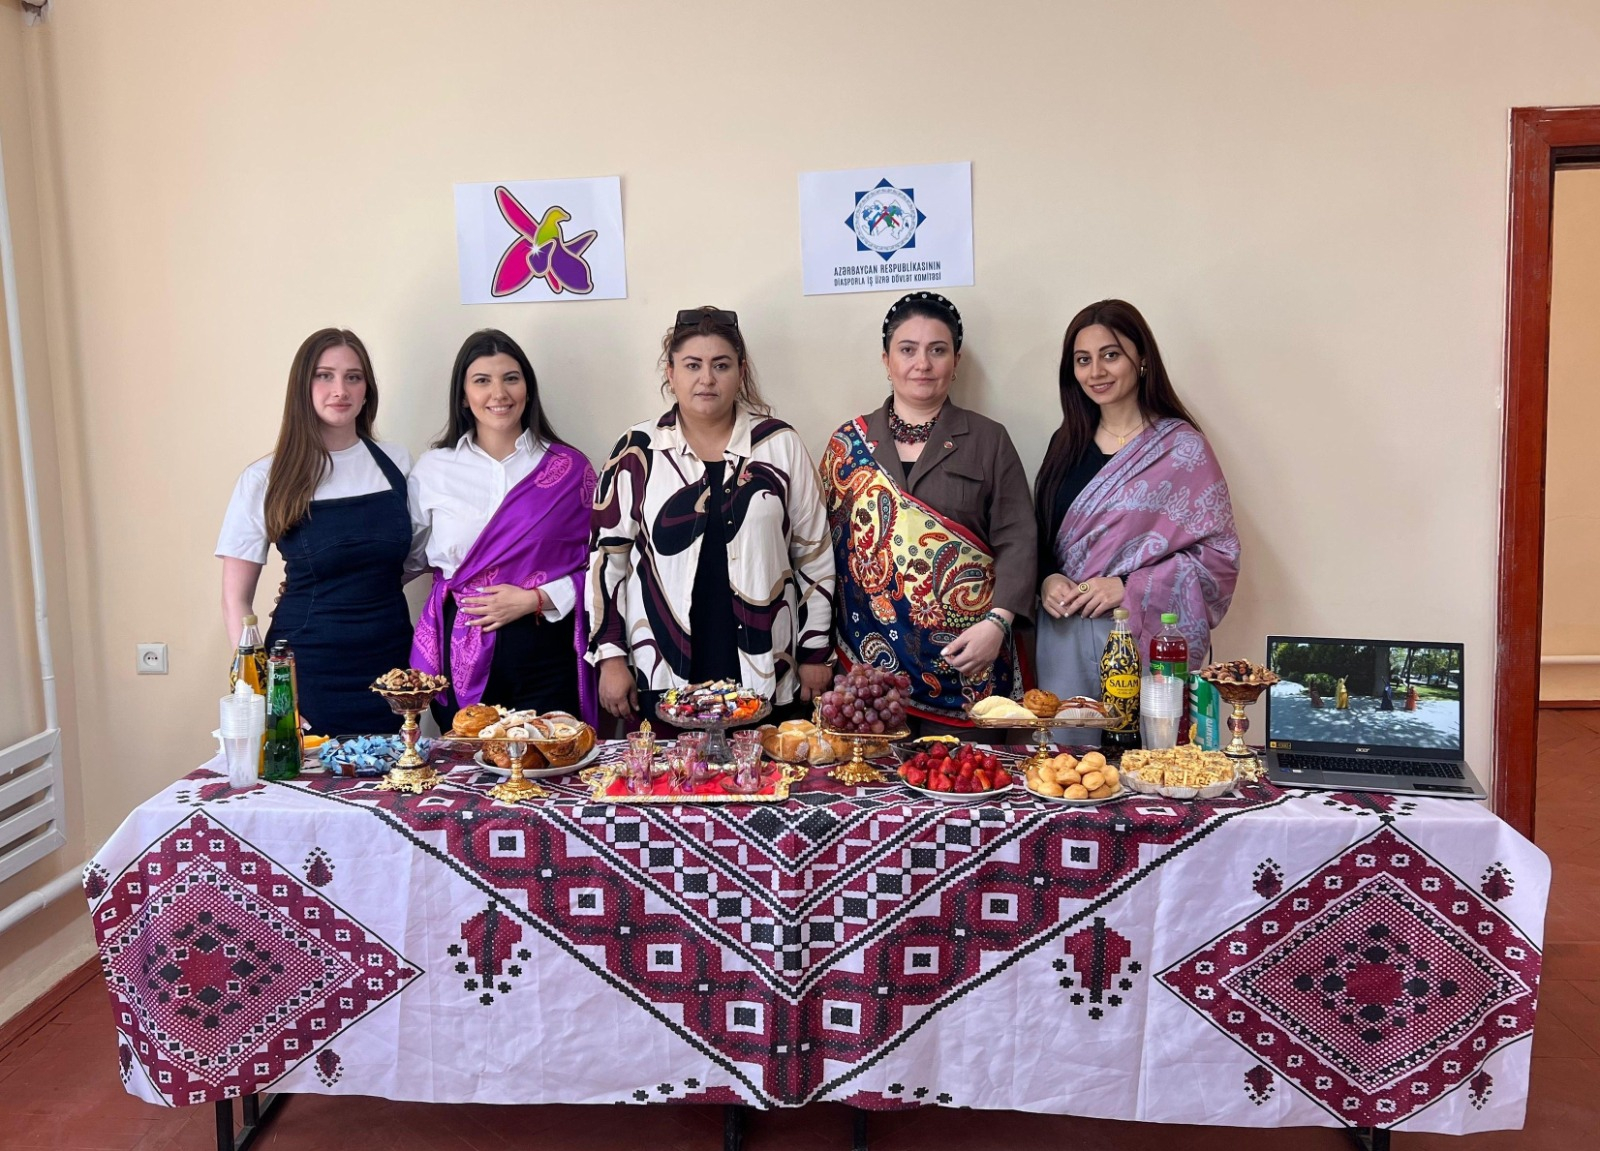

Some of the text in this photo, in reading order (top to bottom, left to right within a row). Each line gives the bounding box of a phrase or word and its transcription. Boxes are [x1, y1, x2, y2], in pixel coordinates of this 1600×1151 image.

[834, 261, 941, 276] AZƏRBAYCAN RESPUBLİKASININ
[1109, 679, 1138, 688] SALAM
